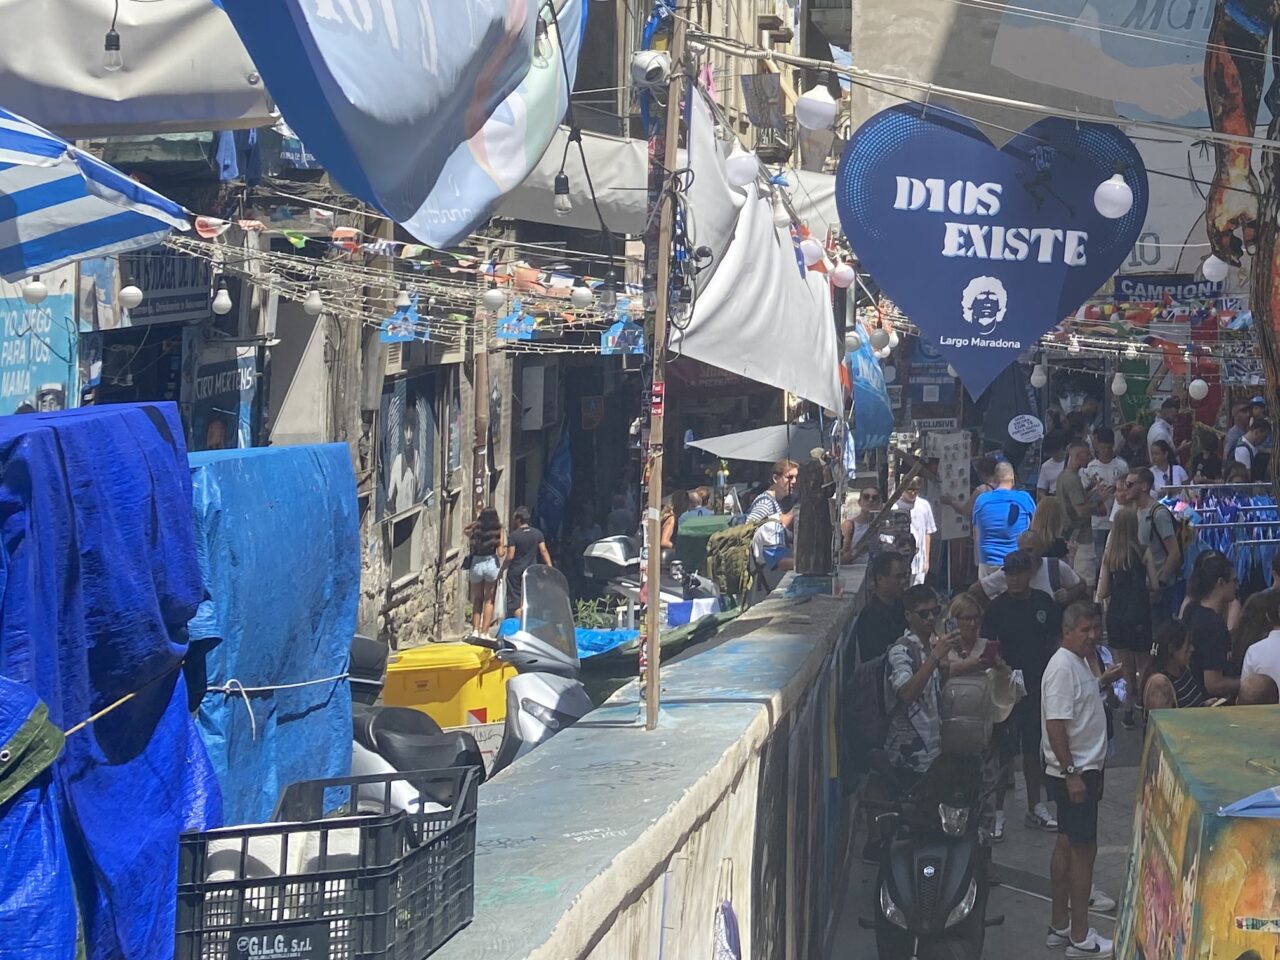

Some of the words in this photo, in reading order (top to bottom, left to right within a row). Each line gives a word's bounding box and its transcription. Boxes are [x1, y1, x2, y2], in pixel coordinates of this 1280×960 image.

[942, 222, 1088, 266] EXISTE
[940, 336, 969, 349] Largo
[971, 337, 1021, 349] Maradona
[215, 367, 252, 394] MERTENS
[248, 934, 288, 956] G.L.G.
